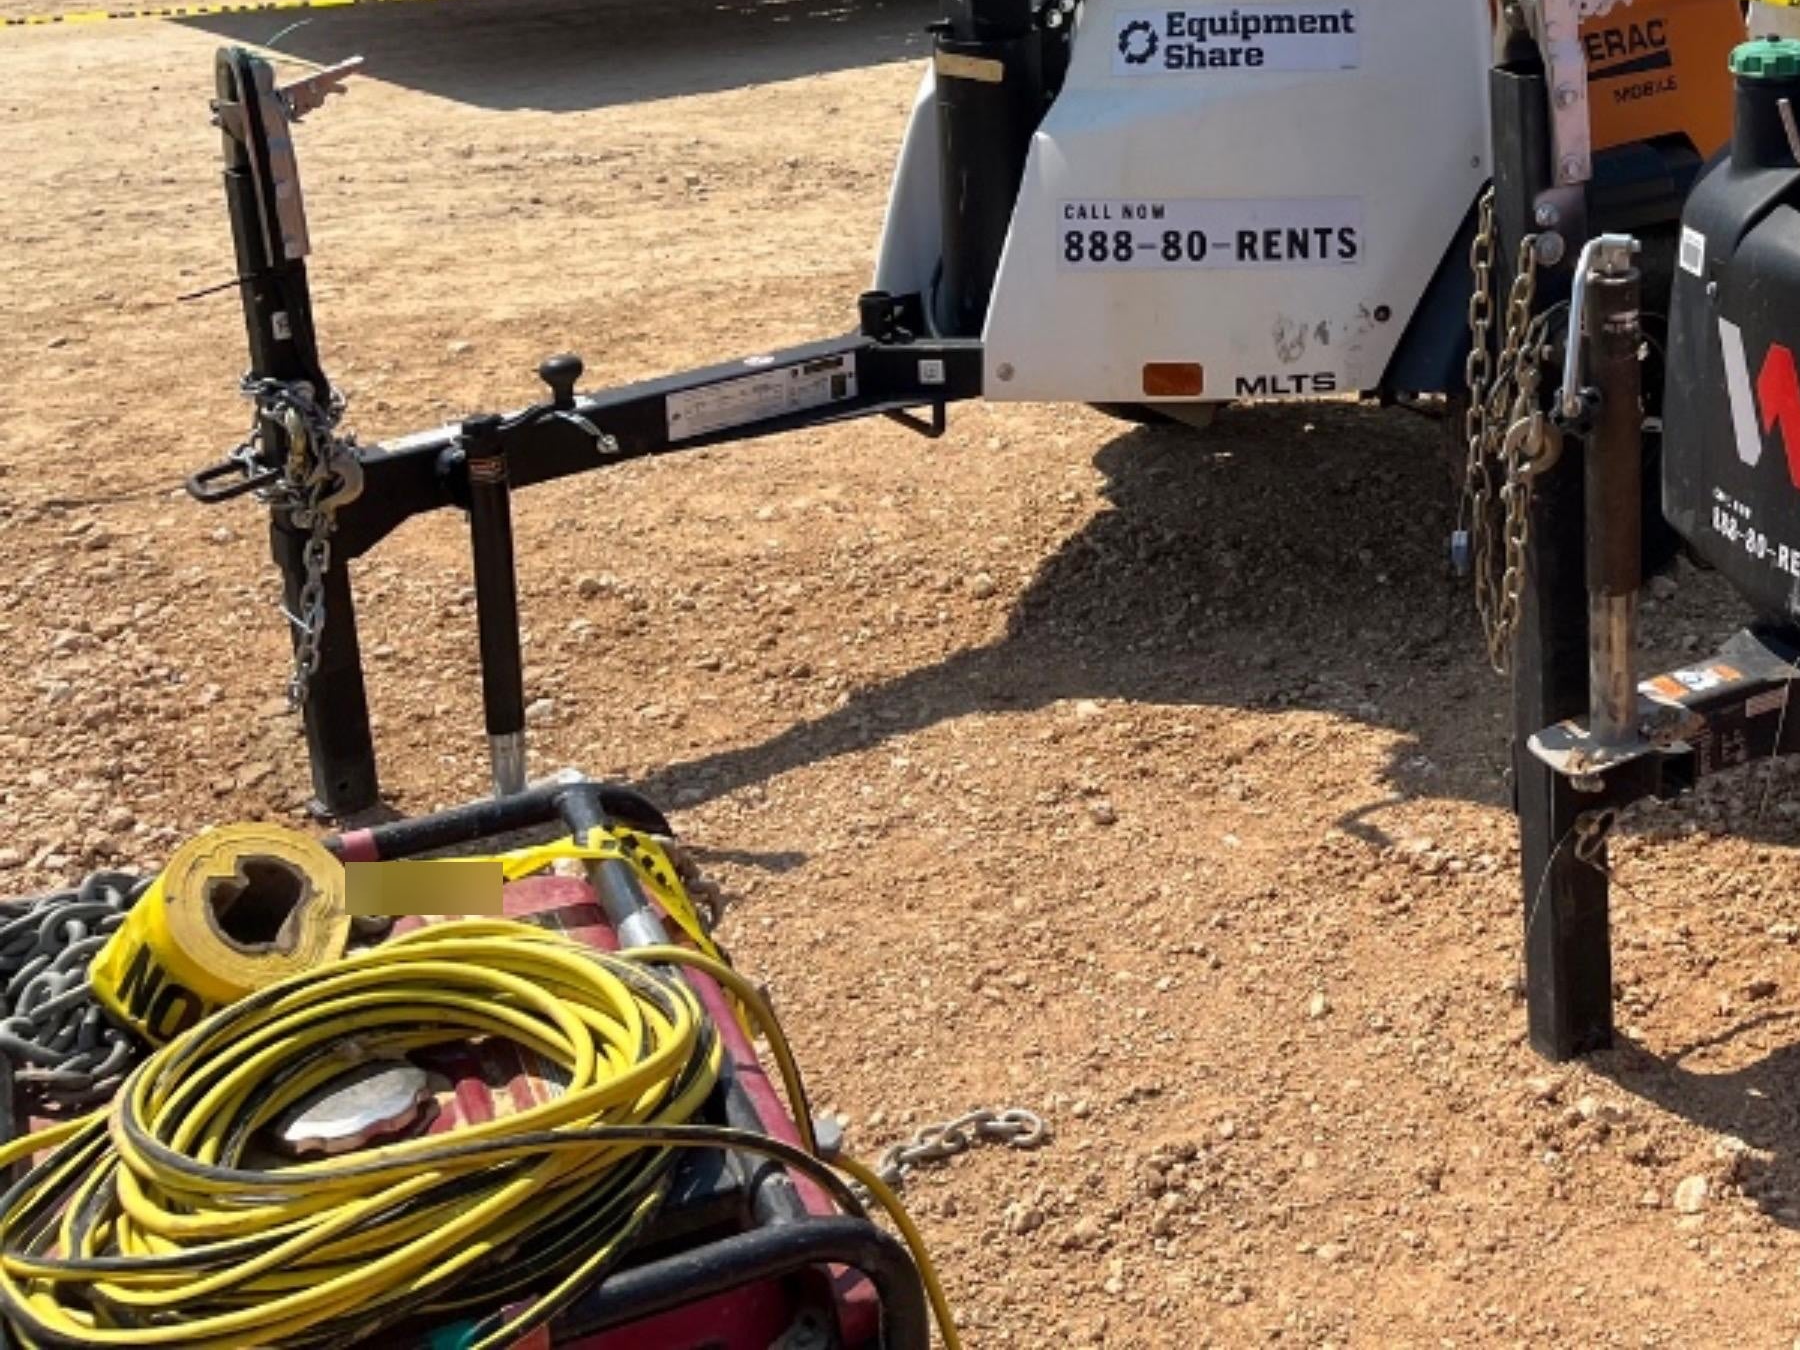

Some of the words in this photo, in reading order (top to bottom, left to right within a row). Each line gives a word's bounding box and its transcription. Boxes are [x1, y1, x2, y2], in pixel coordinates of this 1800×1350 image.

[1165, 8, 1356, 43] Equipment
[1583, 18, 1668, 62] ERAC
[1164, 42, 1265, 70] Share
[1064, 203, 1112, 220] CALL
[1121, 203, 1166, 220] NOW
[1064, 226, 1358, 262] 888-80-RENTS
[1235, 371, 1336, 396] MLTS
